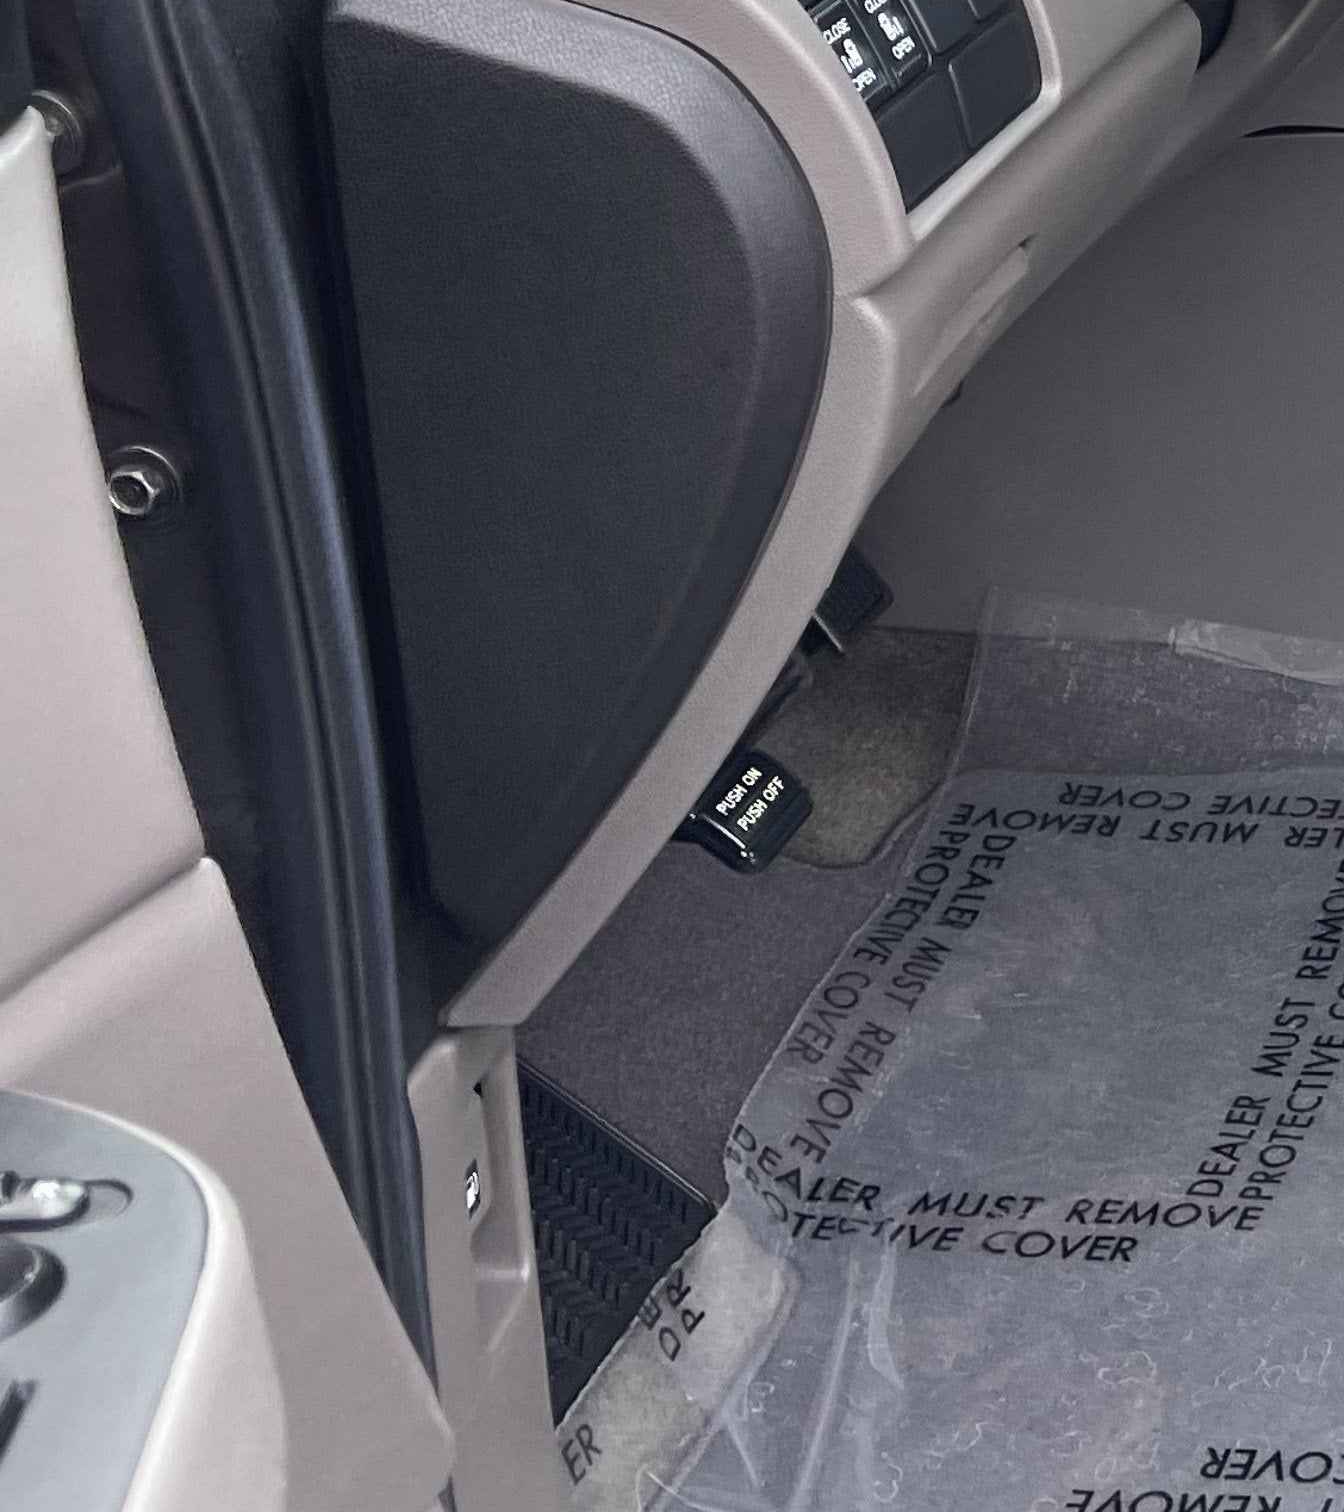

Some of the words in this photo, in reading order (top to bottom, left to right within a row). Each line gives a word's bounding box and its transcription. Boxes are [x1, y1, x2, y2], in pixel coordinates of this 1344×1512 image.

[823, 18, 851, 45] CLOSE
[892, 36, 915, 60] OPEN
[715, 783, 748, 816] PUSH
[742, 767, 762, 786] ON
[737, 799, 768, 831] PUSH
[763, 776, 784, 801] OFF
[1058, 782, 1191, 811] COVER
[949, 803, 1121, 838] REMOVE
[1139, 818, 1259, 844] MUST
[853, 830, 970, 966] PROTECTIVE
[936, 834, 1017, 930] DEALER
[884, 937, 951, 1013] MUST
[787, 971, 872, 1065] COVER
[789, 1021, 896, 1164] REMOVE
[1186, 1094, 1271, 1198] DEALER
[1251, 997, 1316, 1077] MUST
[732, 1124, 881, 1211] DEALER
[907, 1190, 1045, 1220] MUST
[1065, 1197, 1264, 1233] REMOVE
[982, 1229, 1139, 1263] COVER
